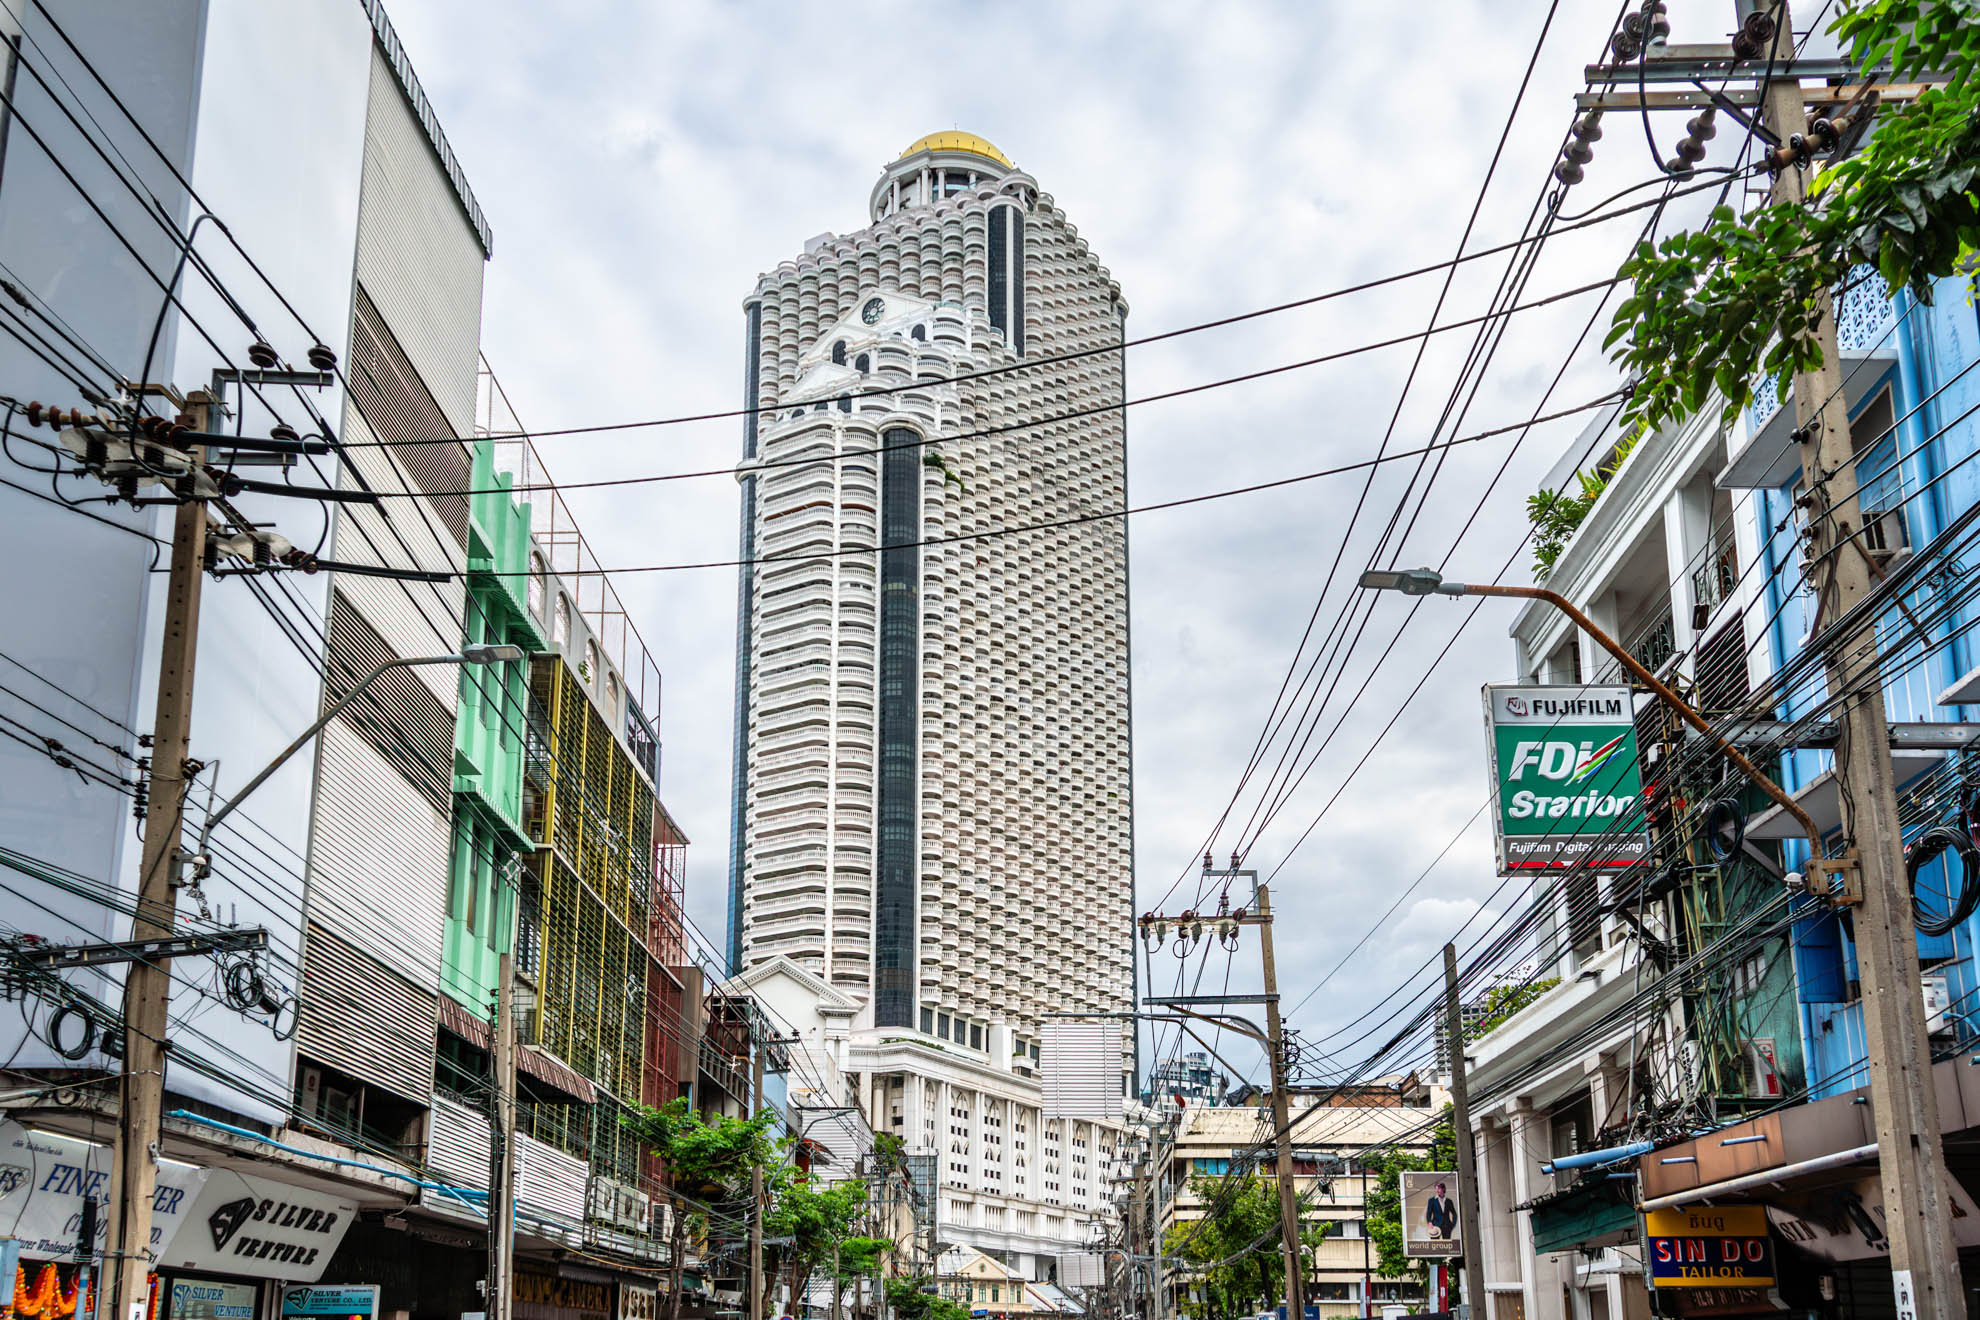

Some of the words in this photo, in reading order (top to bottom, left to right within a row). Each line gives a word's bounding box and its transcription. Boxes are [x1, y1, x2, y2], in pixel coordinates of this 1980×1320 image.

[1533, 699, 1622, 715] FUJIFILM
[40, 1163, 109, 1199] FINE
[252, 1198, 338, 1234] SILVER
[234, 1236, 319, 1265] VENTURE
[1431, 1242, 1453, 1250] group
[1656, 1239, 1706, 1262] SIN
[1720, 1239, 1764, 1262] DO
[1678, 1266, 1744, 1279] TAILOR
[192, 1286, 224, 1301] SILVER
[215, 1304, 253, 1318] VENTURE
